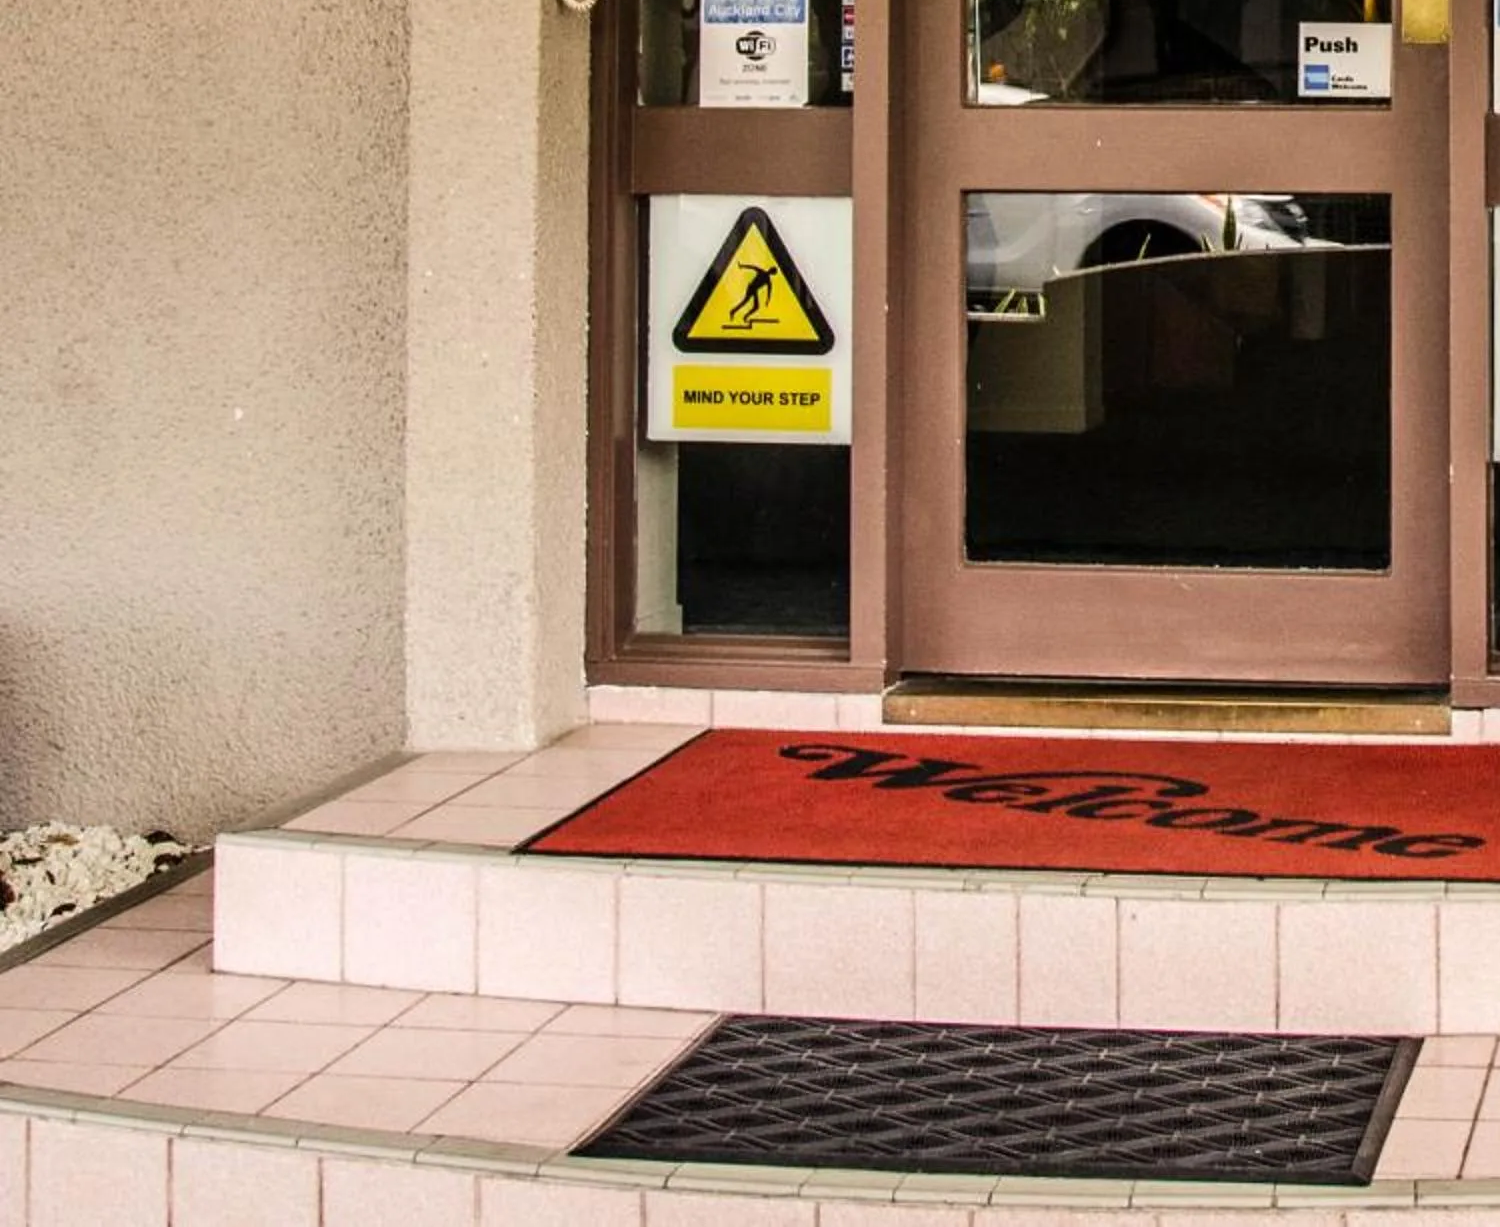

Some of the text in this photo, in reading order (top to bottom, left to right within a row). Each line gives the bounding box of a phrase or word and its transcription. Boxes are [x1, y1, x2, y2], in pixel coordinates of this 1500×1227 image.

[708, 4, 801, 19] Auckland City
[1304, 36, 1359, 53] Push
[683, 389, 821, 407] MIND YOUR STEP
[778, 743, 1487, 860] Welcome
